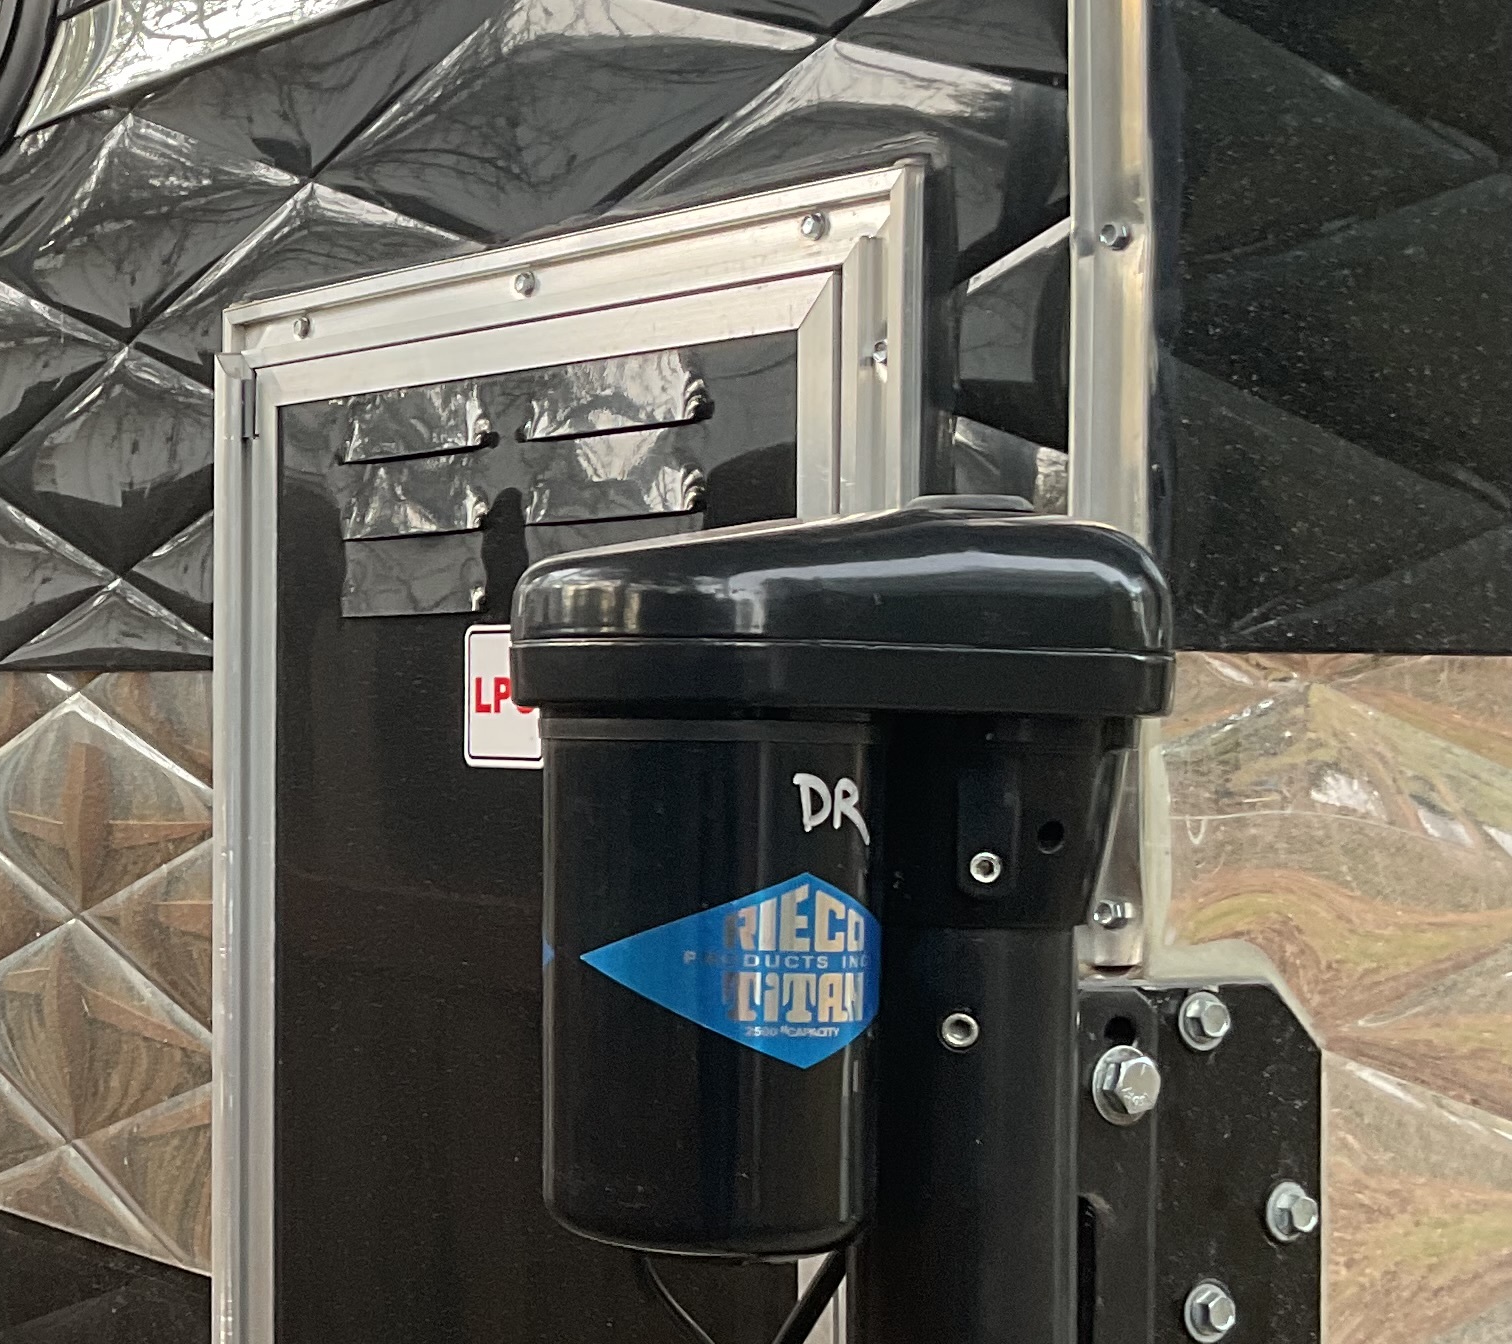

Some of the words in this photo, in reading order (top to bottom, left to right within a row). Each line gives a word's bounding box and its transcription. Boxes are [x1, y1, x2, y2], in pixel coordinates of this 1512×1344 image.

[474, 676, 535, 714] LP
[792, 772, 870, 846] DR
[723, 884, 865, 953] RIECO
[683, 950, 829, 969] PDUCTS
